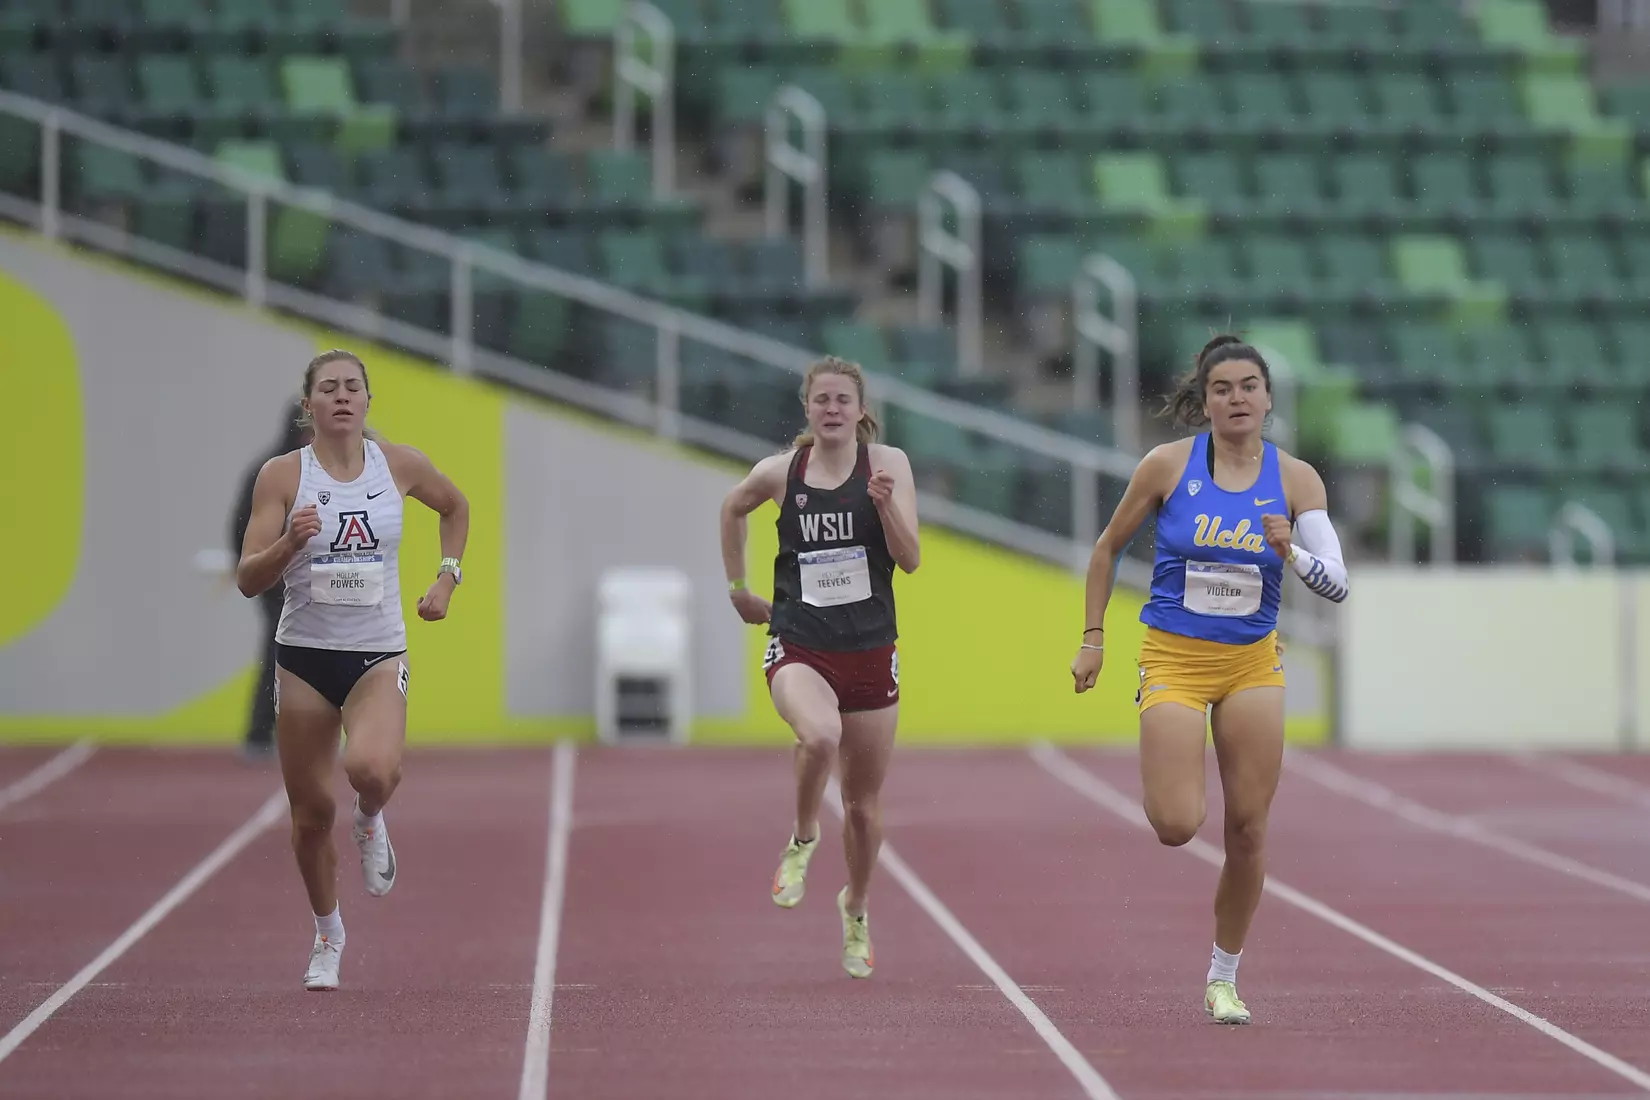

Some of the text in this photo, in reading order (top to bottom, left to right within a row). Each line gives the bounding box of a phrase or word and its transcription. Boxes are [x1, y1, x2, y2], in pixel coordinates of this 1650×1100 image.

[330, 510, 379, 552] A
[798, 511, 854, 542] WSU
[1193, 513, 1265, 553] Ucla
[330, 580, 365, 589] POWERS
[817, 577, 851, 588] TEEVENS
[1205, 585, 1242, 597] VIDELER
